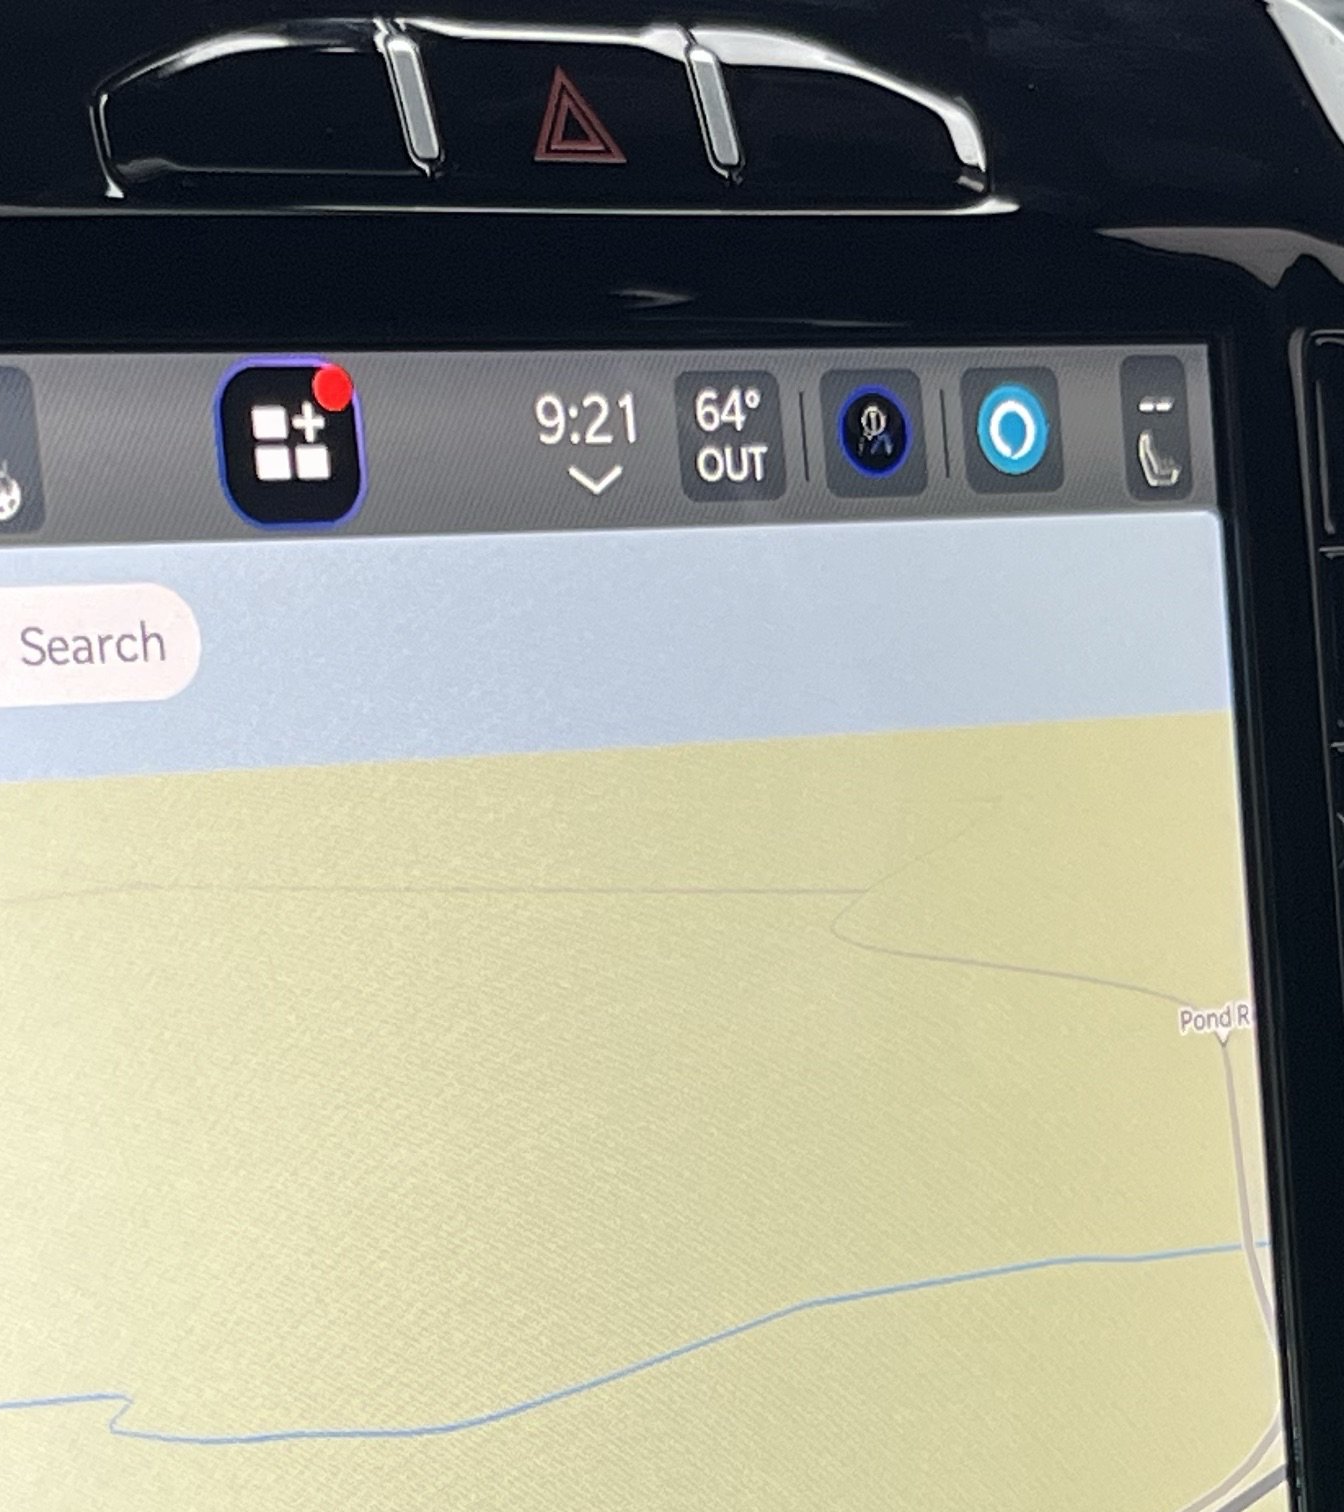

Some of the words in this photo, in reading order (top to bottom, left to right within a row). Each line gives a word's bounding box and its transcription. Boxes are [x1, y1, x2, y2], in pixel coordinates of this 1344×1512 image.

[534, 391, 639, 446] 9:21
[693, 387, 761, 433] 64°
[696, 444, 768, 483] OUT
[19, 620, 167, 667] Search
[1180, 1004, 1232, 1033] Pond
